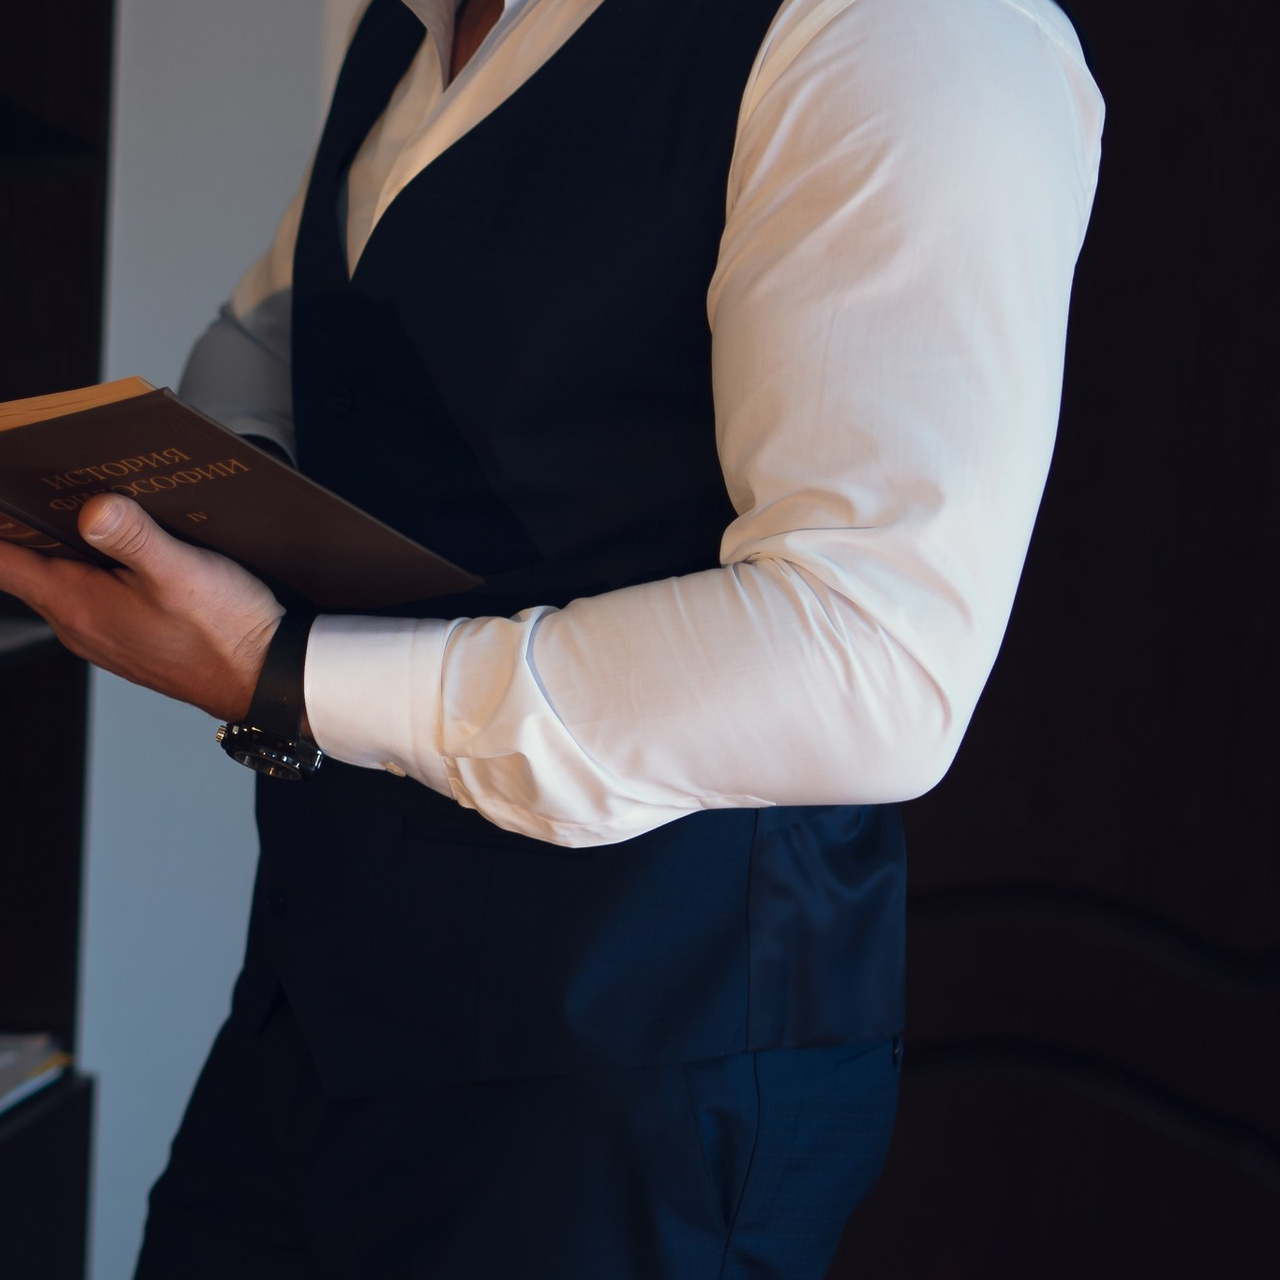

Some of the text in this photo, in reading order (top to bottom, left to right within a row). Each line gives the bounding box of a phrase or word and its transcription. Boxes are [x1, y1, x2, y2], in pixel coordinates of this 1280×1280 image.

[39, 446, 192, 491] ИСТОРИЯ
[49, 459, 251, 511] ФИОСОФИИ
[186, 510, 211, 523] IV
